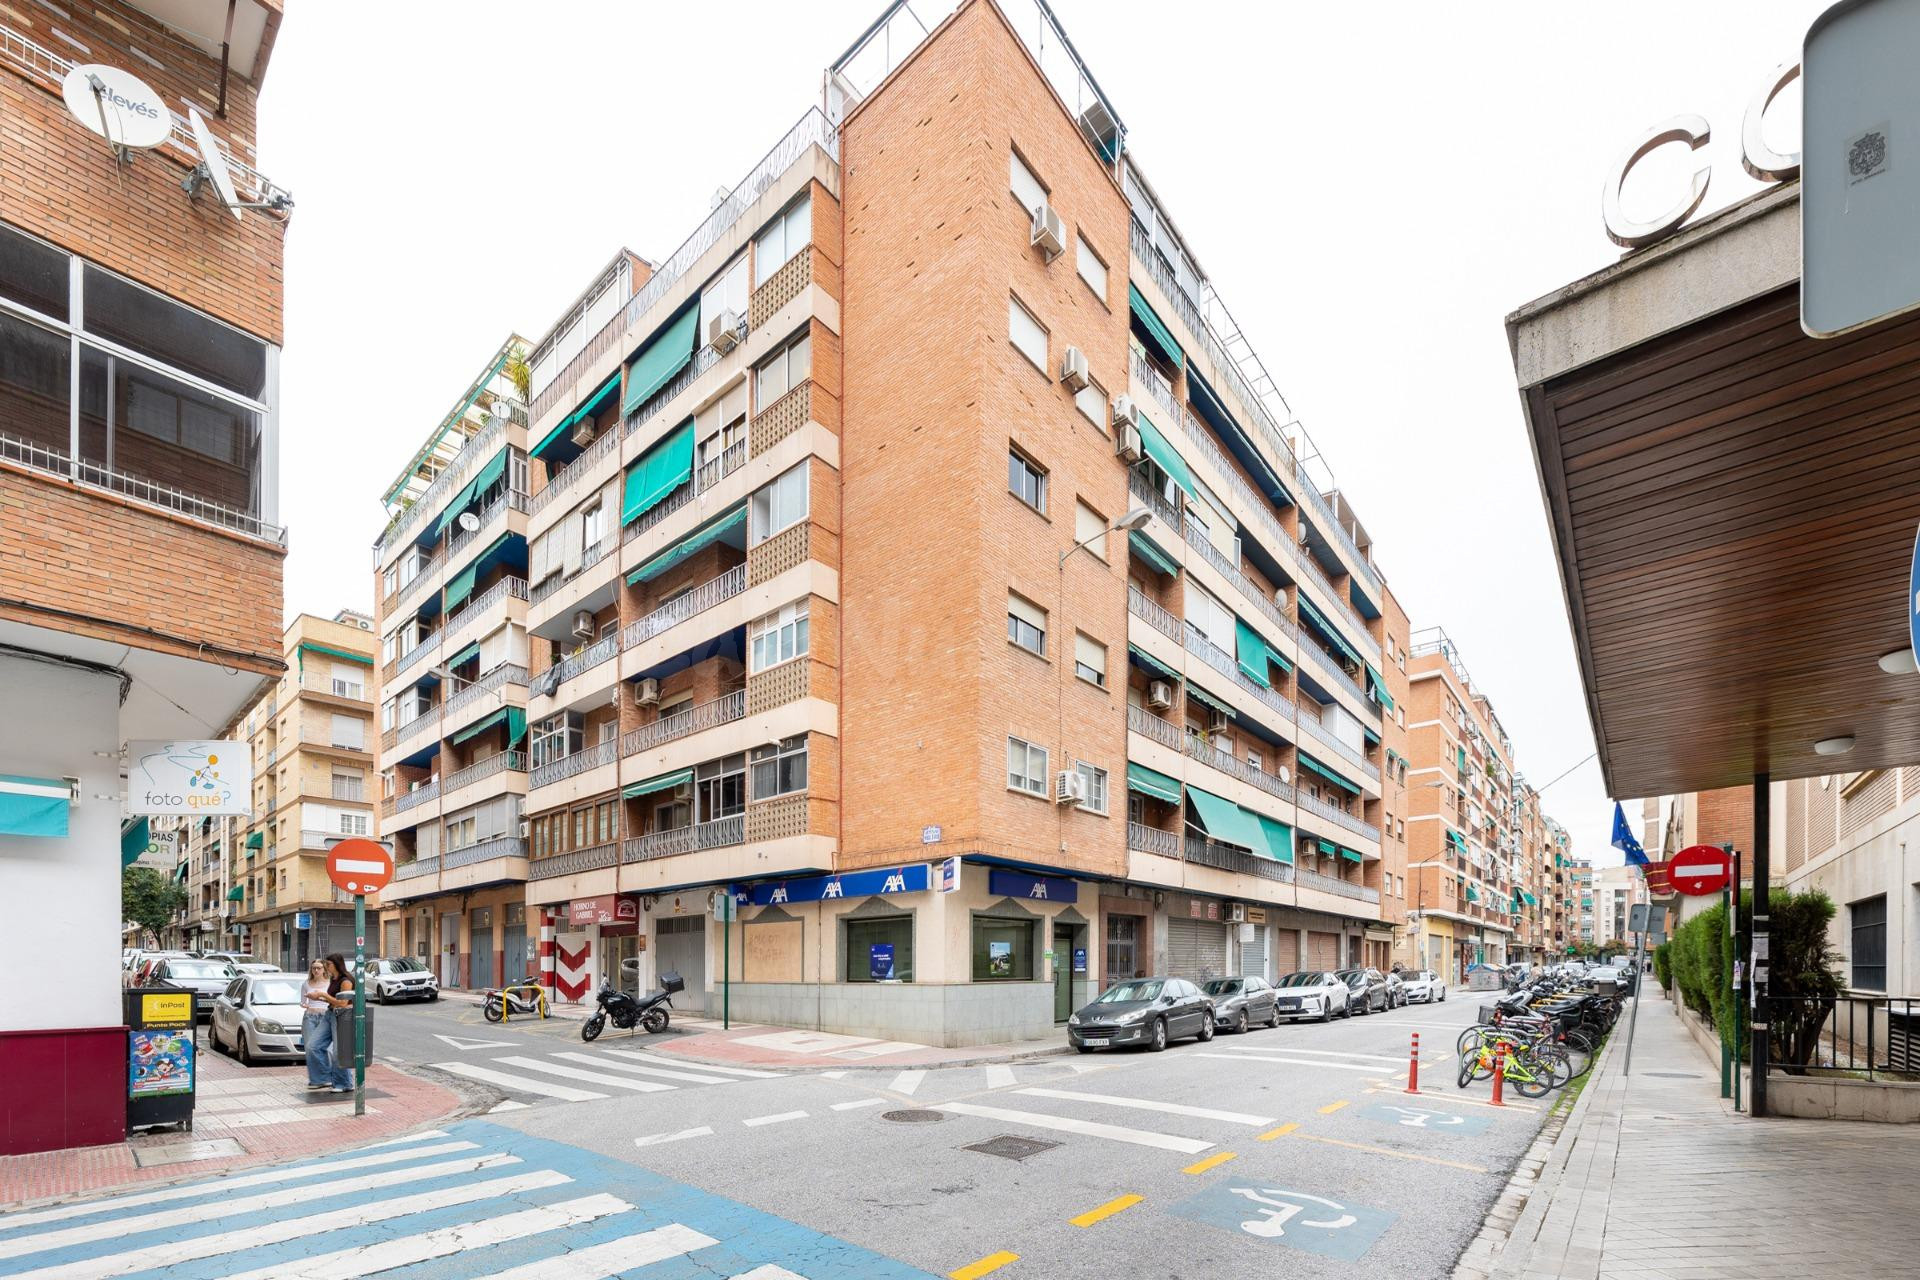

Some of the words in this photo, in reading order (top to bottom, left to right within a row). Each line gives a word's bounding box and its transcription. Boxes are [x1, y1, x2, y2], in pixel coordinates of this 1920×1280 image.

[89, 80, 158, 119] levés
[145, 791, 183, 806] foto
[187, 790, 232, 809] qué?
[822, 881, 843, 899] AXA
[881, 874, 906, 893] AXA
[1029, 882, 1048, 899] AXA
[736, 892, 748, 902] AXA
[769, 887, 788, 903] AXA
